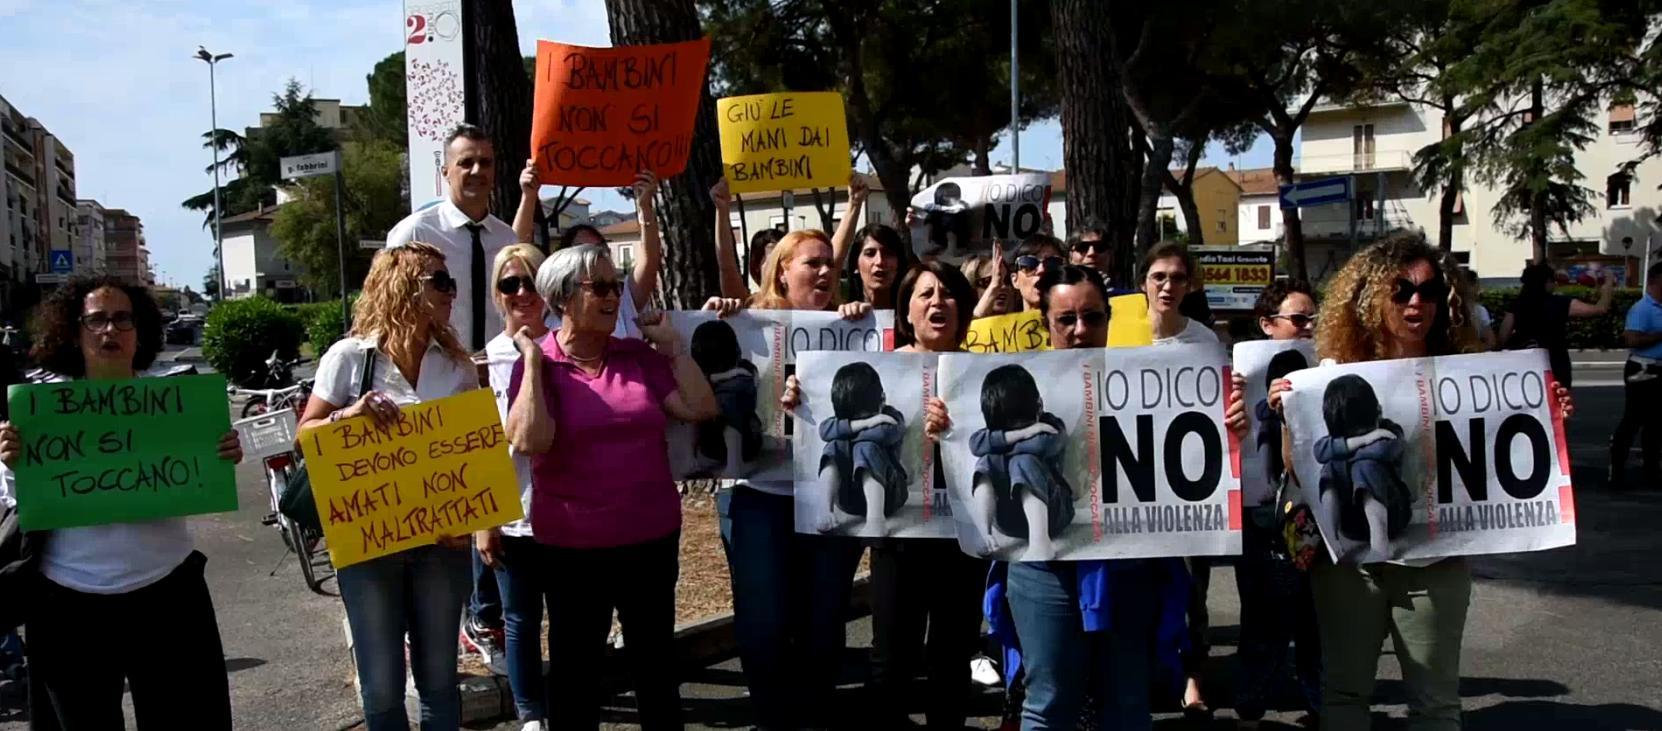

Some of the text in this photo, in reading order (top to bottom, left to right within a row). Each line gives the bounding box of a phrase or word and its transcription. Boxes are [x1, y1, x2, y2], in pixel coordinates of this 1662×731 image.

[547, 52, 676, 91] I BAMBINI
[558, 103, 659, 134] NON SI
[770, 99, 795, 120] LE
[741, 126, 830, 153] MANI DAI
[730, 154, 813, 181] BAMBINI
[985, 183, 1044, 202] IO DICO
[982, 202, 1041, 240] NO
[1203, 267, 1268, 281] 564 1833
[29, 384, 183, 416] I BAMBINI
[1097, 365, 1220, 411] IO DICO
[1429, 371, 1544, 415] IO DICO
[26, 429, 132, 467] NON SI
[313, 432, 323, 456] I
[336, 421, 505, 482] DEVONO ESSERE
[1098, 411, 1223, 504] NO
[1434, 413, 1551, 504] NO
[51, 455, 203, 498] TOCCANO!
[328, 462, 469, 526] AMATI NON
[360, 487, 500, 554] MALTRATTATI
[1103, 503, 1224, 535] ALLA VIOLENZA
[1439, 500, 1557, 533] ALLA VIOLENZA
